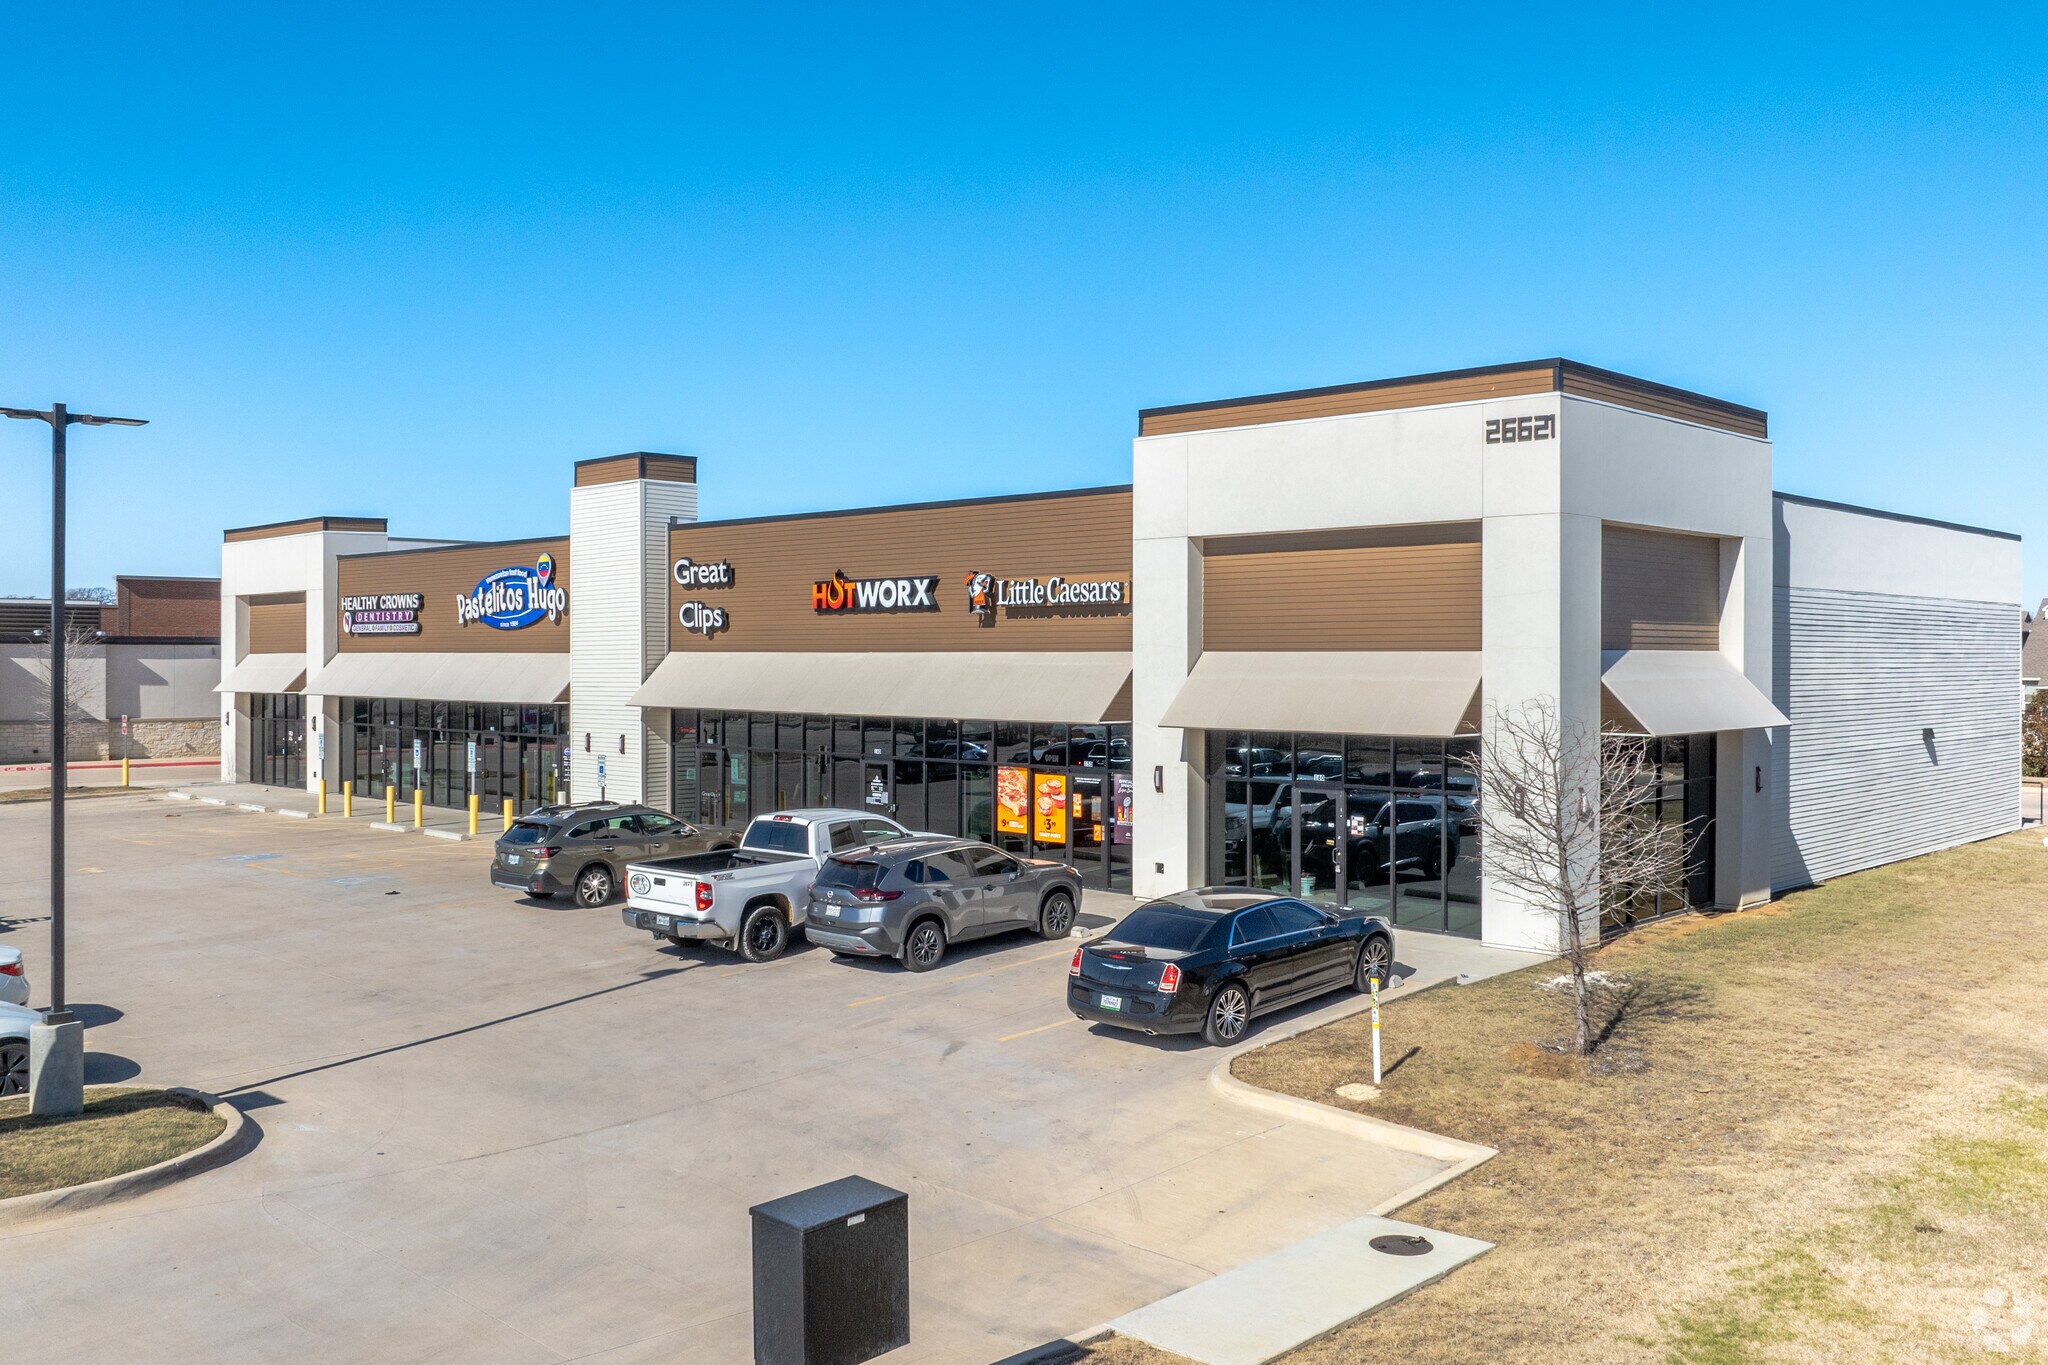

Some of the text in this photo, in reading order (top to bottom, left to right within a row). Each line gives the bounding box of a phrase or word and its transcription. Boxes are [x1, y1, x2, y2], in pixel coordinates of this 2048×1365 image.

[1486, 414, 1555, 444] 26621
[674, 559, 728, 585] Great
[341, 594, 419, 611] HEALTHY CROWNS
[456, 576, 565, 624] Pastelitos Hugo
[812, 573, 930, 609] HOTWORX
[996, 576, 1121, 606] Little Caesars
[358, 611, 410, 622] DENTISTRY
[679, 602, 723, 635] Clips
[1044, 754, 1059, 763] OPEN
